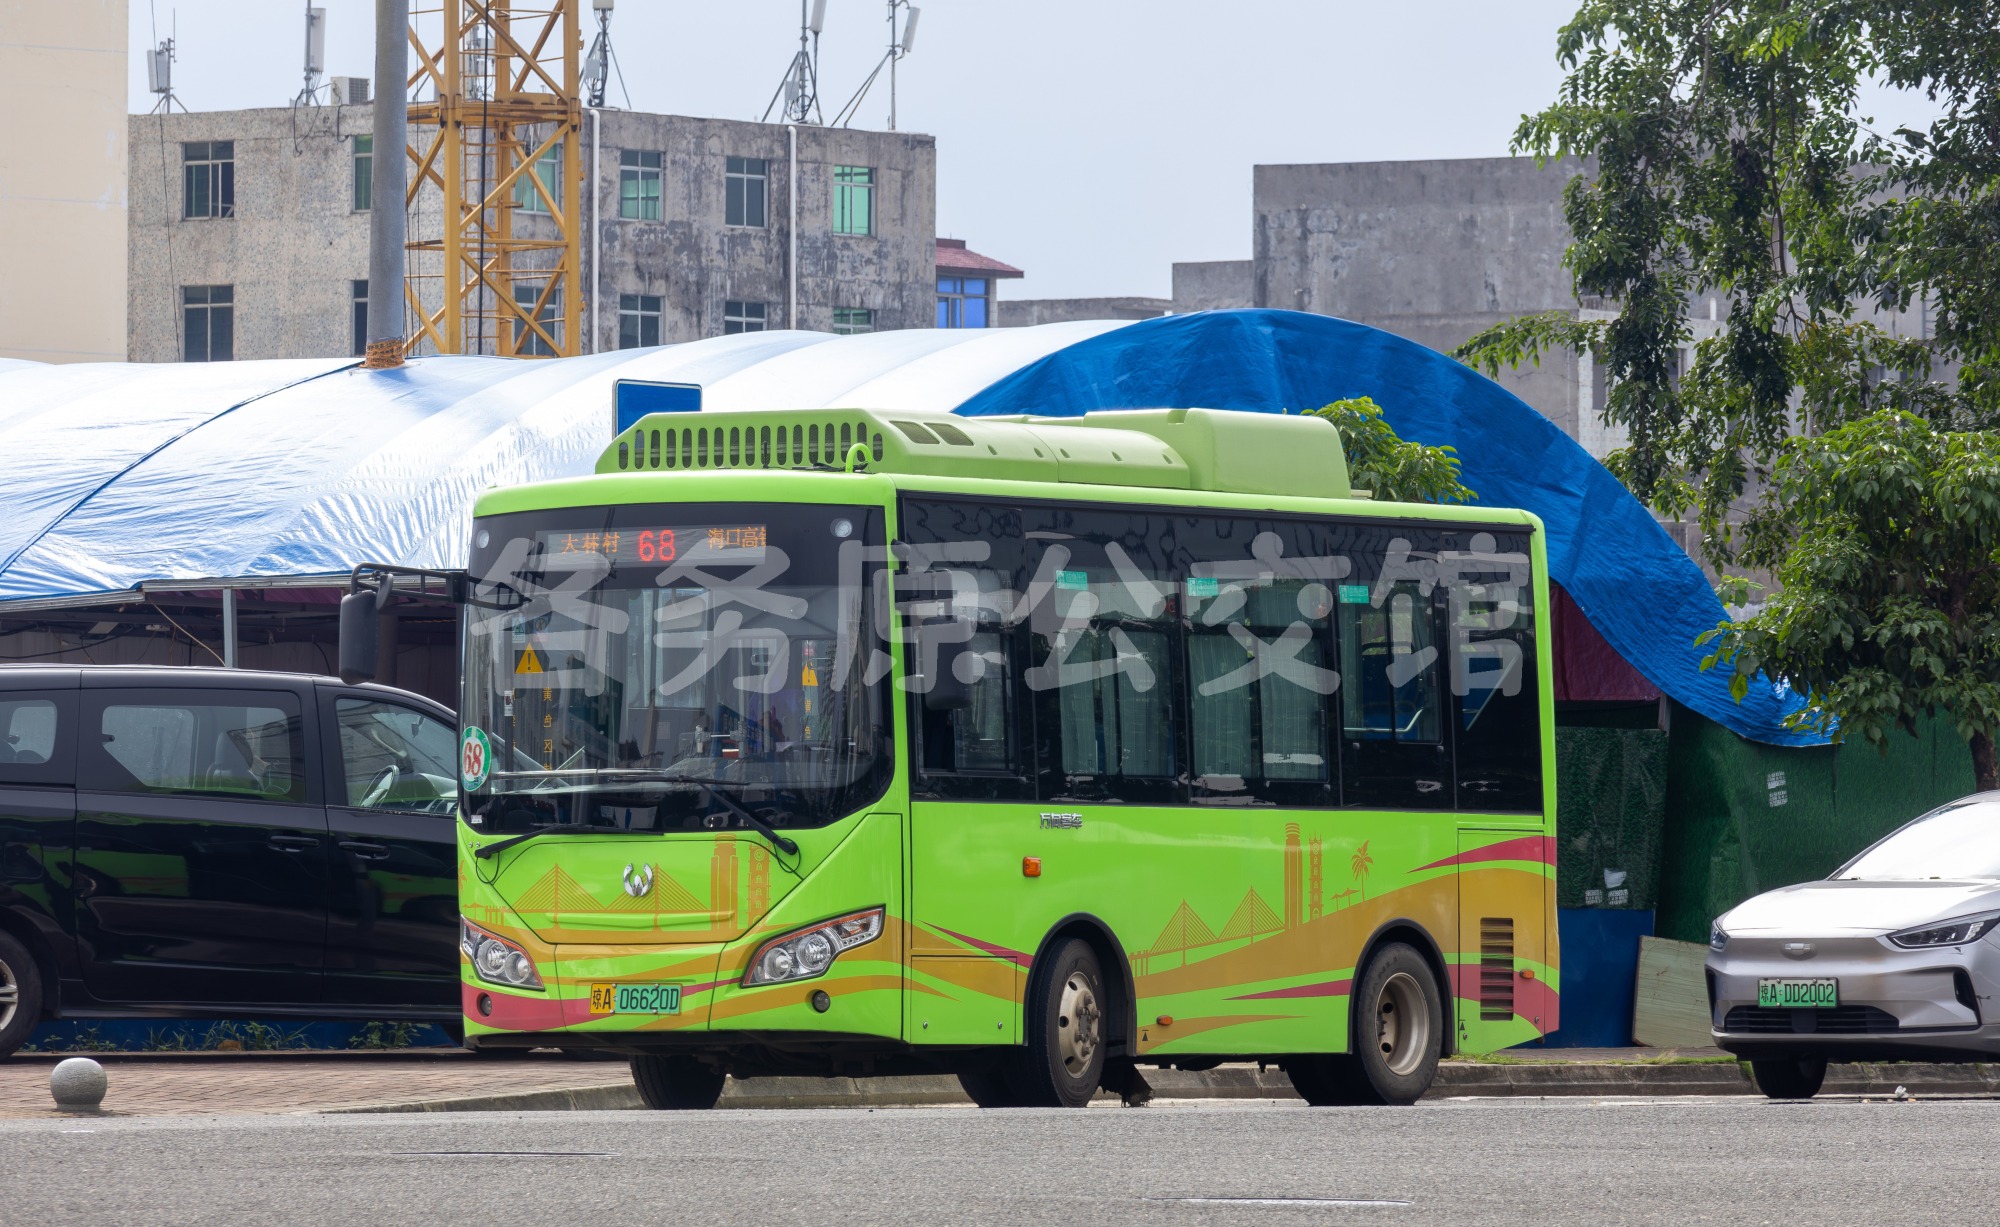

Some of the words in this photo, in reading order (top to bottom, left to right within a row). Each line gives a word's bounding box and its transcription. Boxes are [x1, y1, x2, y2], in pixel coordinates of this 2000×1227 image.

[561, 531, 620, 555] 大林村
[638, 529, 676, 562] 68
[463, 741, 482, 777] 68
